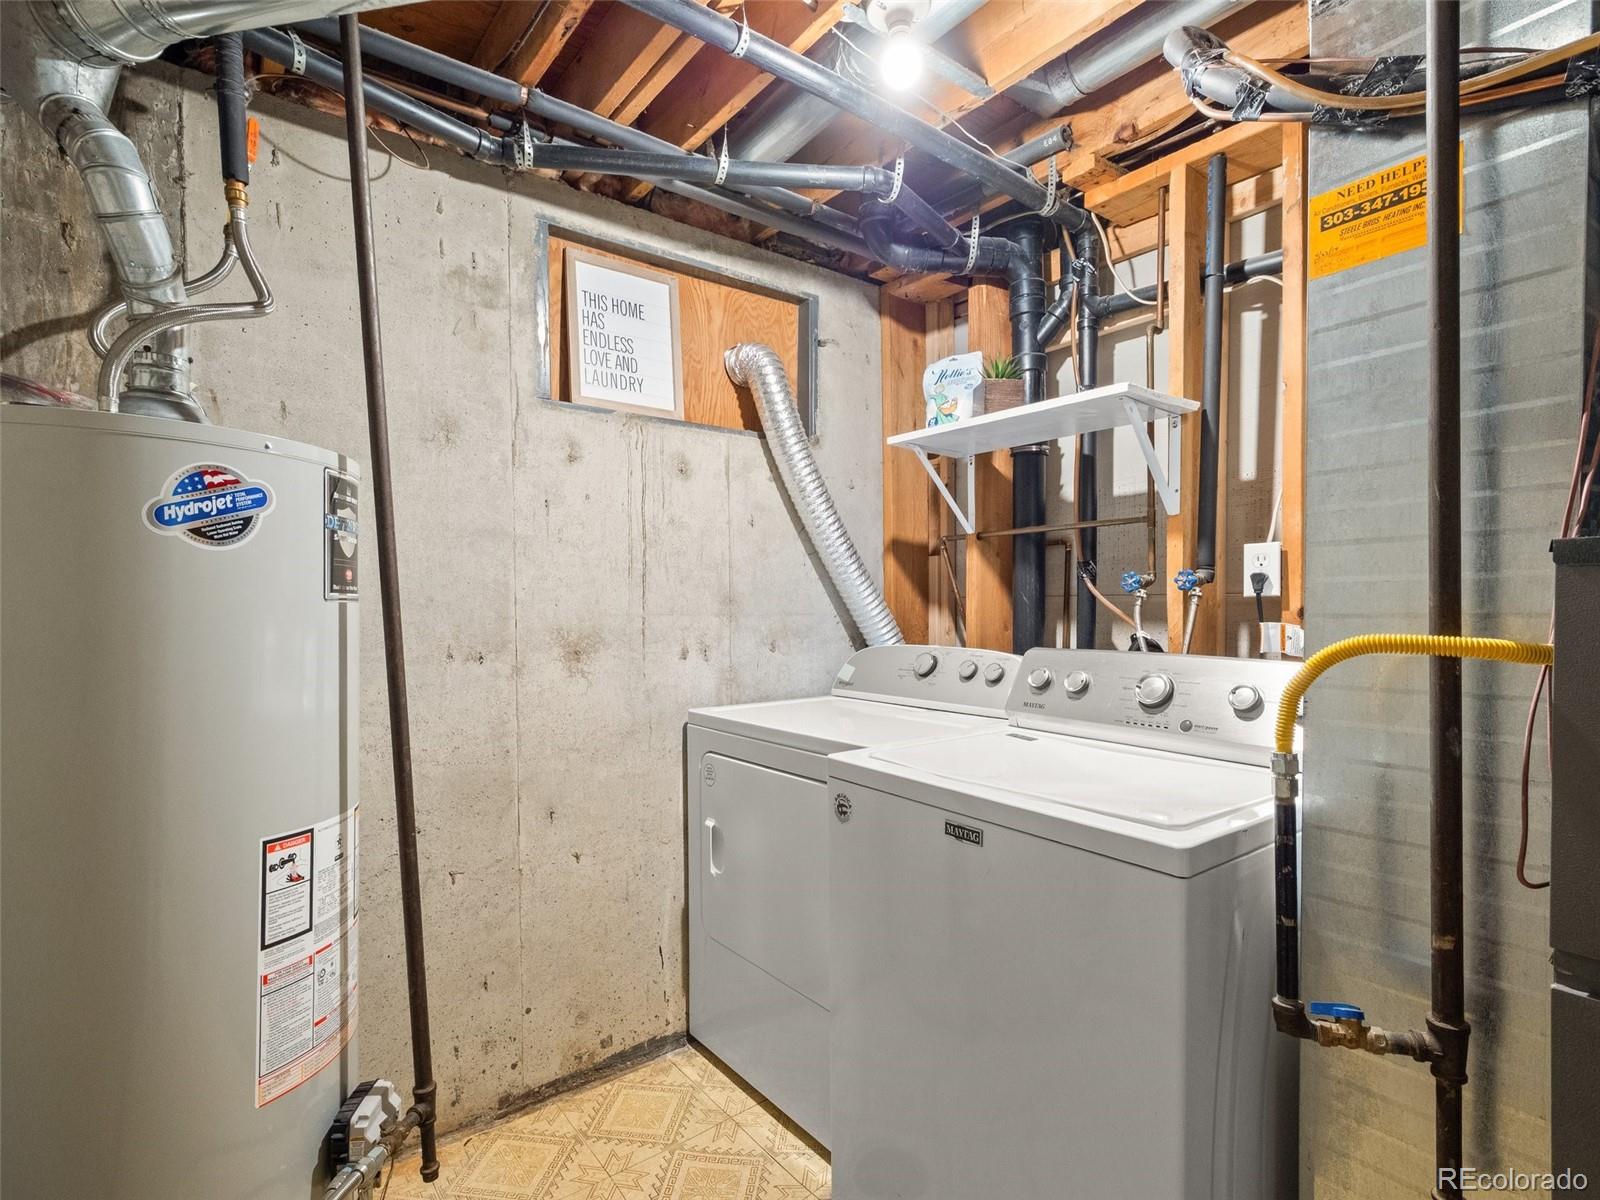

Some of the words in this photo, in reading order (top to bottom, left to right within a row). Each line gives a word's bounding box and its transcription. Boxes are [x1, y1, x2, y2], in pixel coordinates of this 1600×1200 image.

[1337, 179, 1376, 199] NEED
[1323, 182, 1427, 229] 303-347-195
[1340, 222, 1362, 237] STEELE
[1382, 205, 1412, 222] HEATING
[582, 290, 608, 312] THIS
[612, 297, 645, 321] HOME
[582, 309, 605, 330] HAS
[583, 328, 634, 355] ENDLESS
[584, 348, 612, 370] LOVE
[615, 354, 638, 374] AND
[584, 367, 644, 393] LAUNDRY
[932, 368, 972, 386] Nellie's
[164, 494, 233, 522] Hydrojet
[1023, 701, 1047, 710] MAYTAG
[946, 822, 980, 843] MAYTAG
